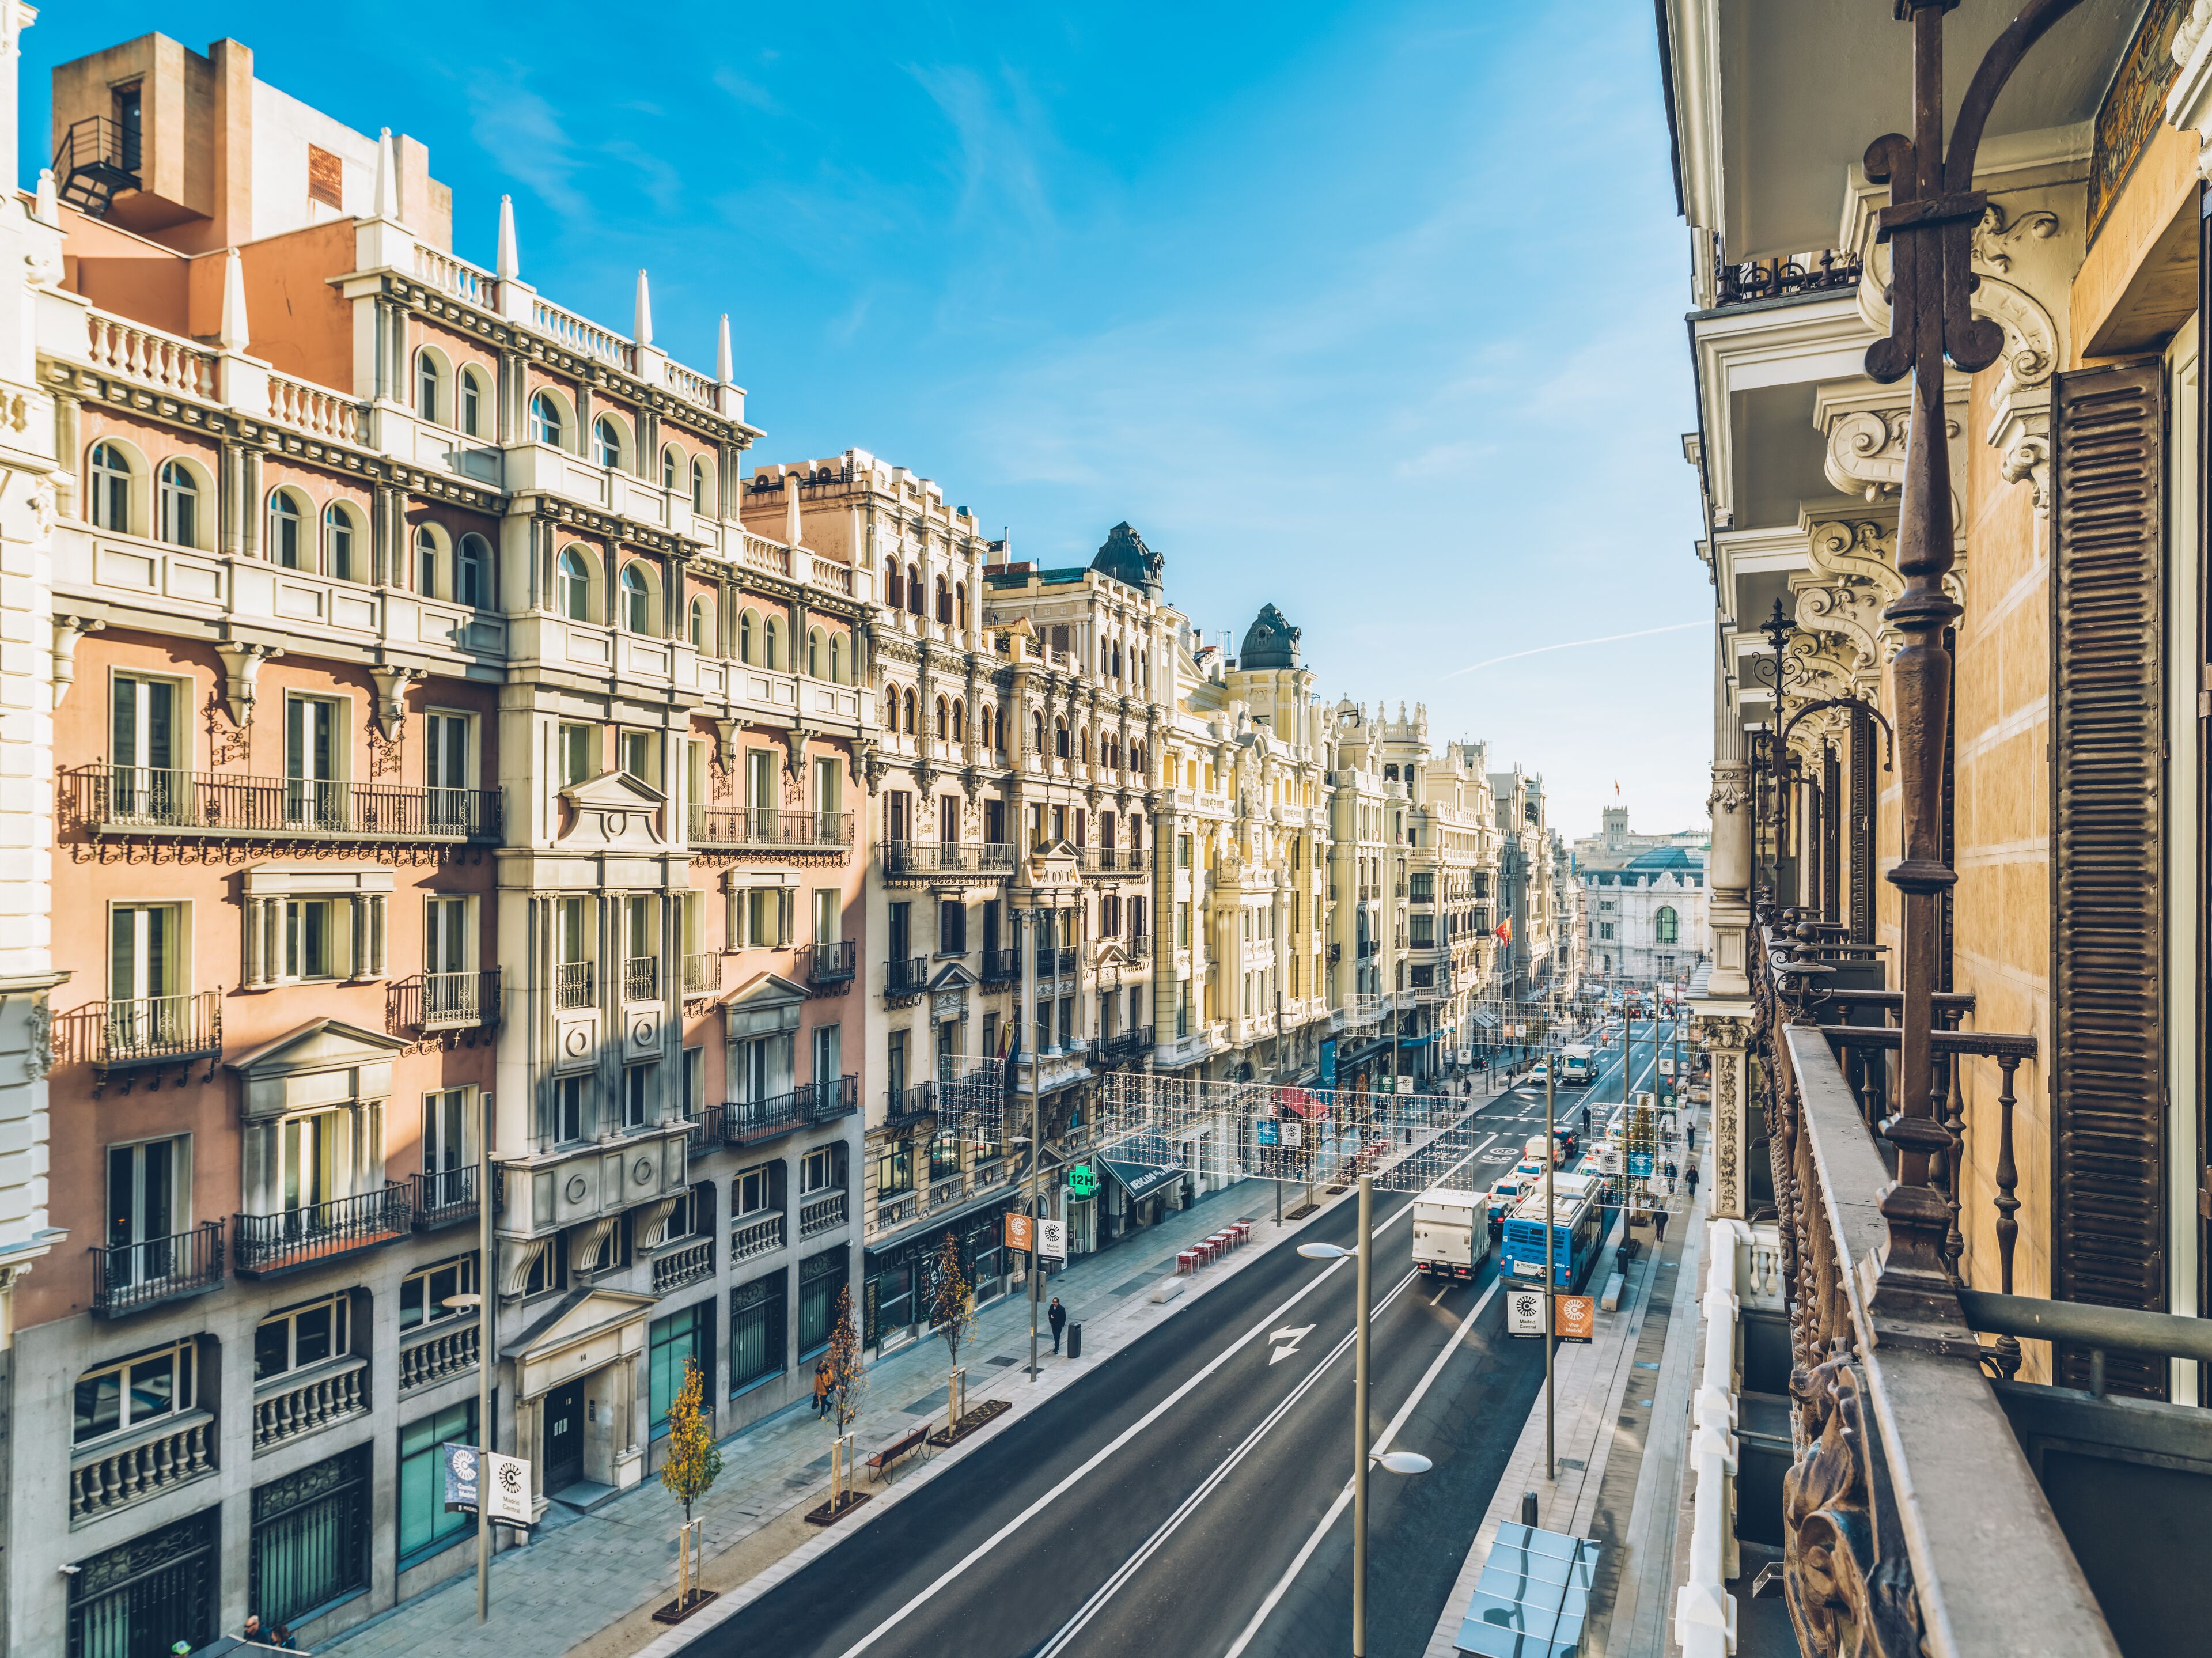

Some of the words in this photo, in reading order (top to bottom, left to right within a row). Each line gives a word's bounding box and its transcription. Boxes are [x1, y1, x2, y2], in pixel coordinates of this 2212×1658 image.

[1071, 1174, 1093, 1186] 12H
[581, 1353, 586, 1362] 14
[503, 1496, 520, 1506] Madrid
[502, 1504, 520, 1513] Central
